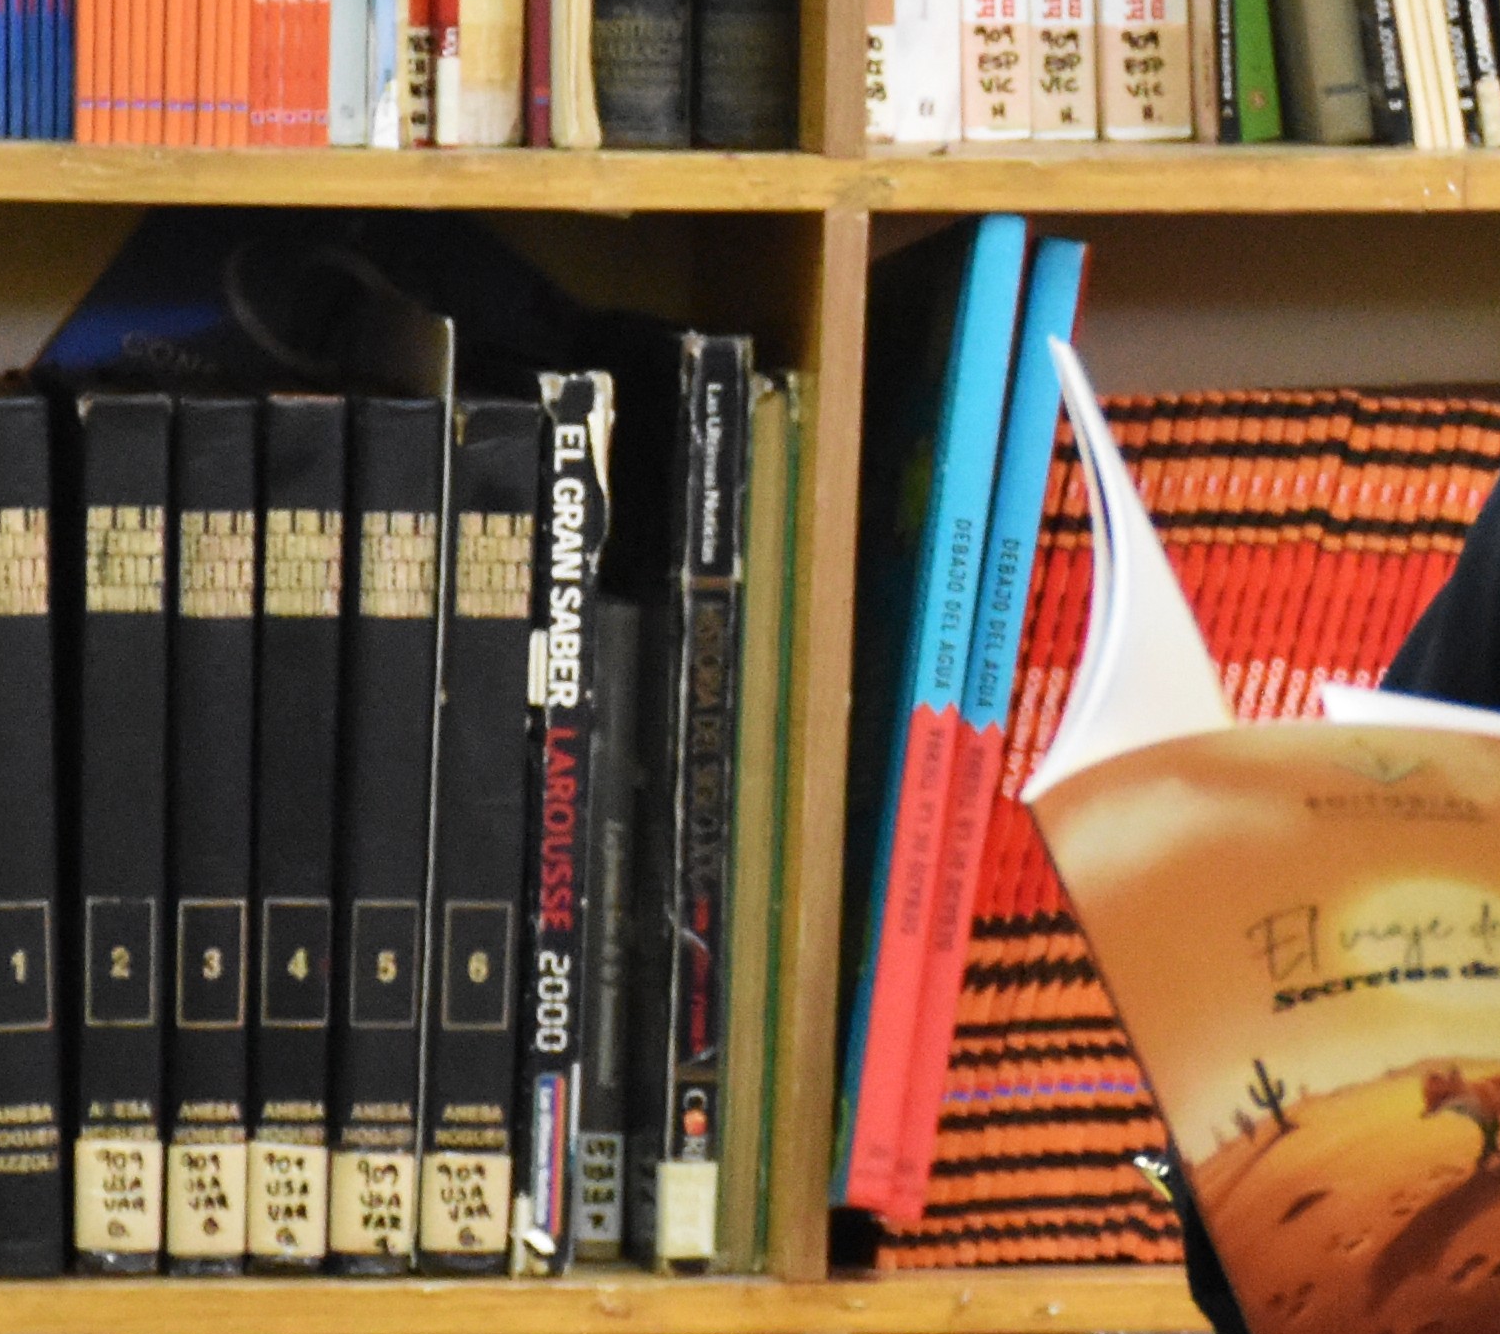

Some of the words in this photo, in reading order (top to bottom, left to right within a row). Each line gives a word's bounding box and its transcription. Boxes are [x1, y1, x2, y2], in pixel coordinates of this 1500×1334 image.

[705, 382, 721, 414] Las
[553, 423, 588, 472] EL
[550, 477, 586, 578] GRAN
[698, 489, 719, 564] Noticias
[945, 517, 972, 592] DEBAJO
[991, 536, 1021, 612] DEBAJO
[940, 599, 961, 631] DEL
[985, 619, 1007, 651] DEL
[545, 585, 582, 708] SABER
[932, 639, 956, 690] AGUA
[975, 657, 1001, 709] AGUA
[542, 726, 577, 931] LAROUSSE
[11, 950, 27, 984] 1
[110, 945, 131, 979] 2
[203, 948, 222, 980] 3
[287, 947, 309, 980] 4
[377, 949, 397, 983] 5
[468, 950, 490, 983] 6
[1245, 906, 1320, 981] El
[1340, 916, 1454, 967] viaje
[535, 950, 571, 1052] 2000
[1273, 963, 1449, 1013] Secretos
